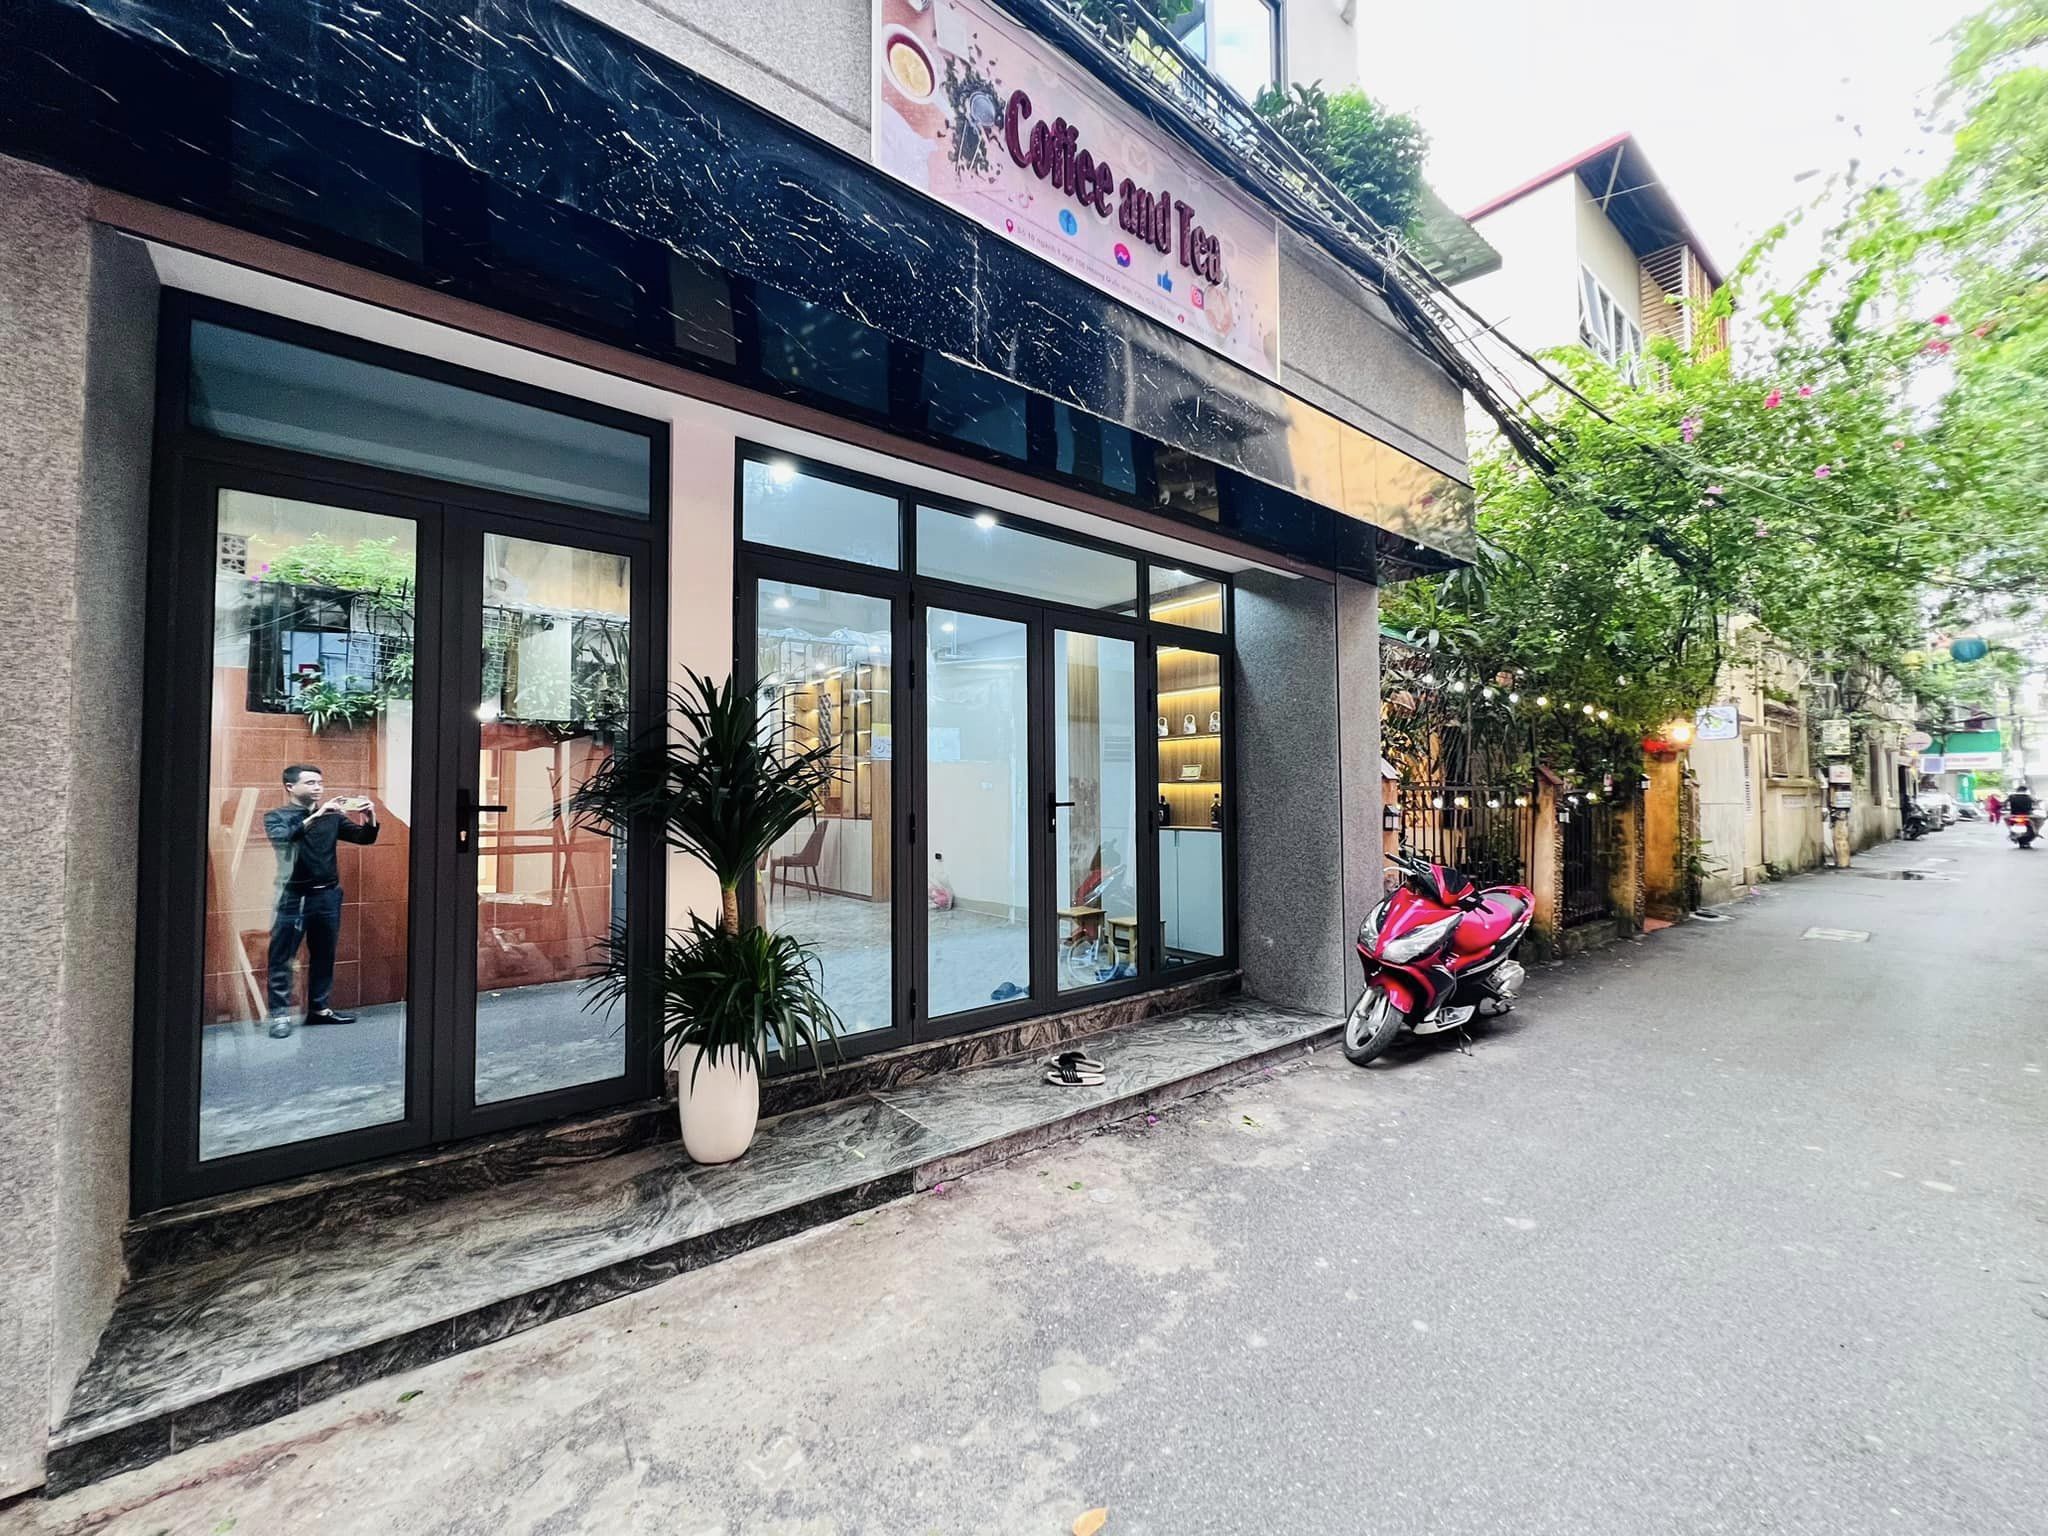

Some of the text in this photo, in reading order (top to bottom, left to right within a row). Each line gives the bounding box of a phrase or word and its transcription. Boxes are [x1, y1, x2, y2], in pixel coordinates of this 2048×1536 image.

[1004, 90, 1114, 217] Coffee
[1118, 178, 1171, 254] and
[1174, 199, 1221, 284] Tea
